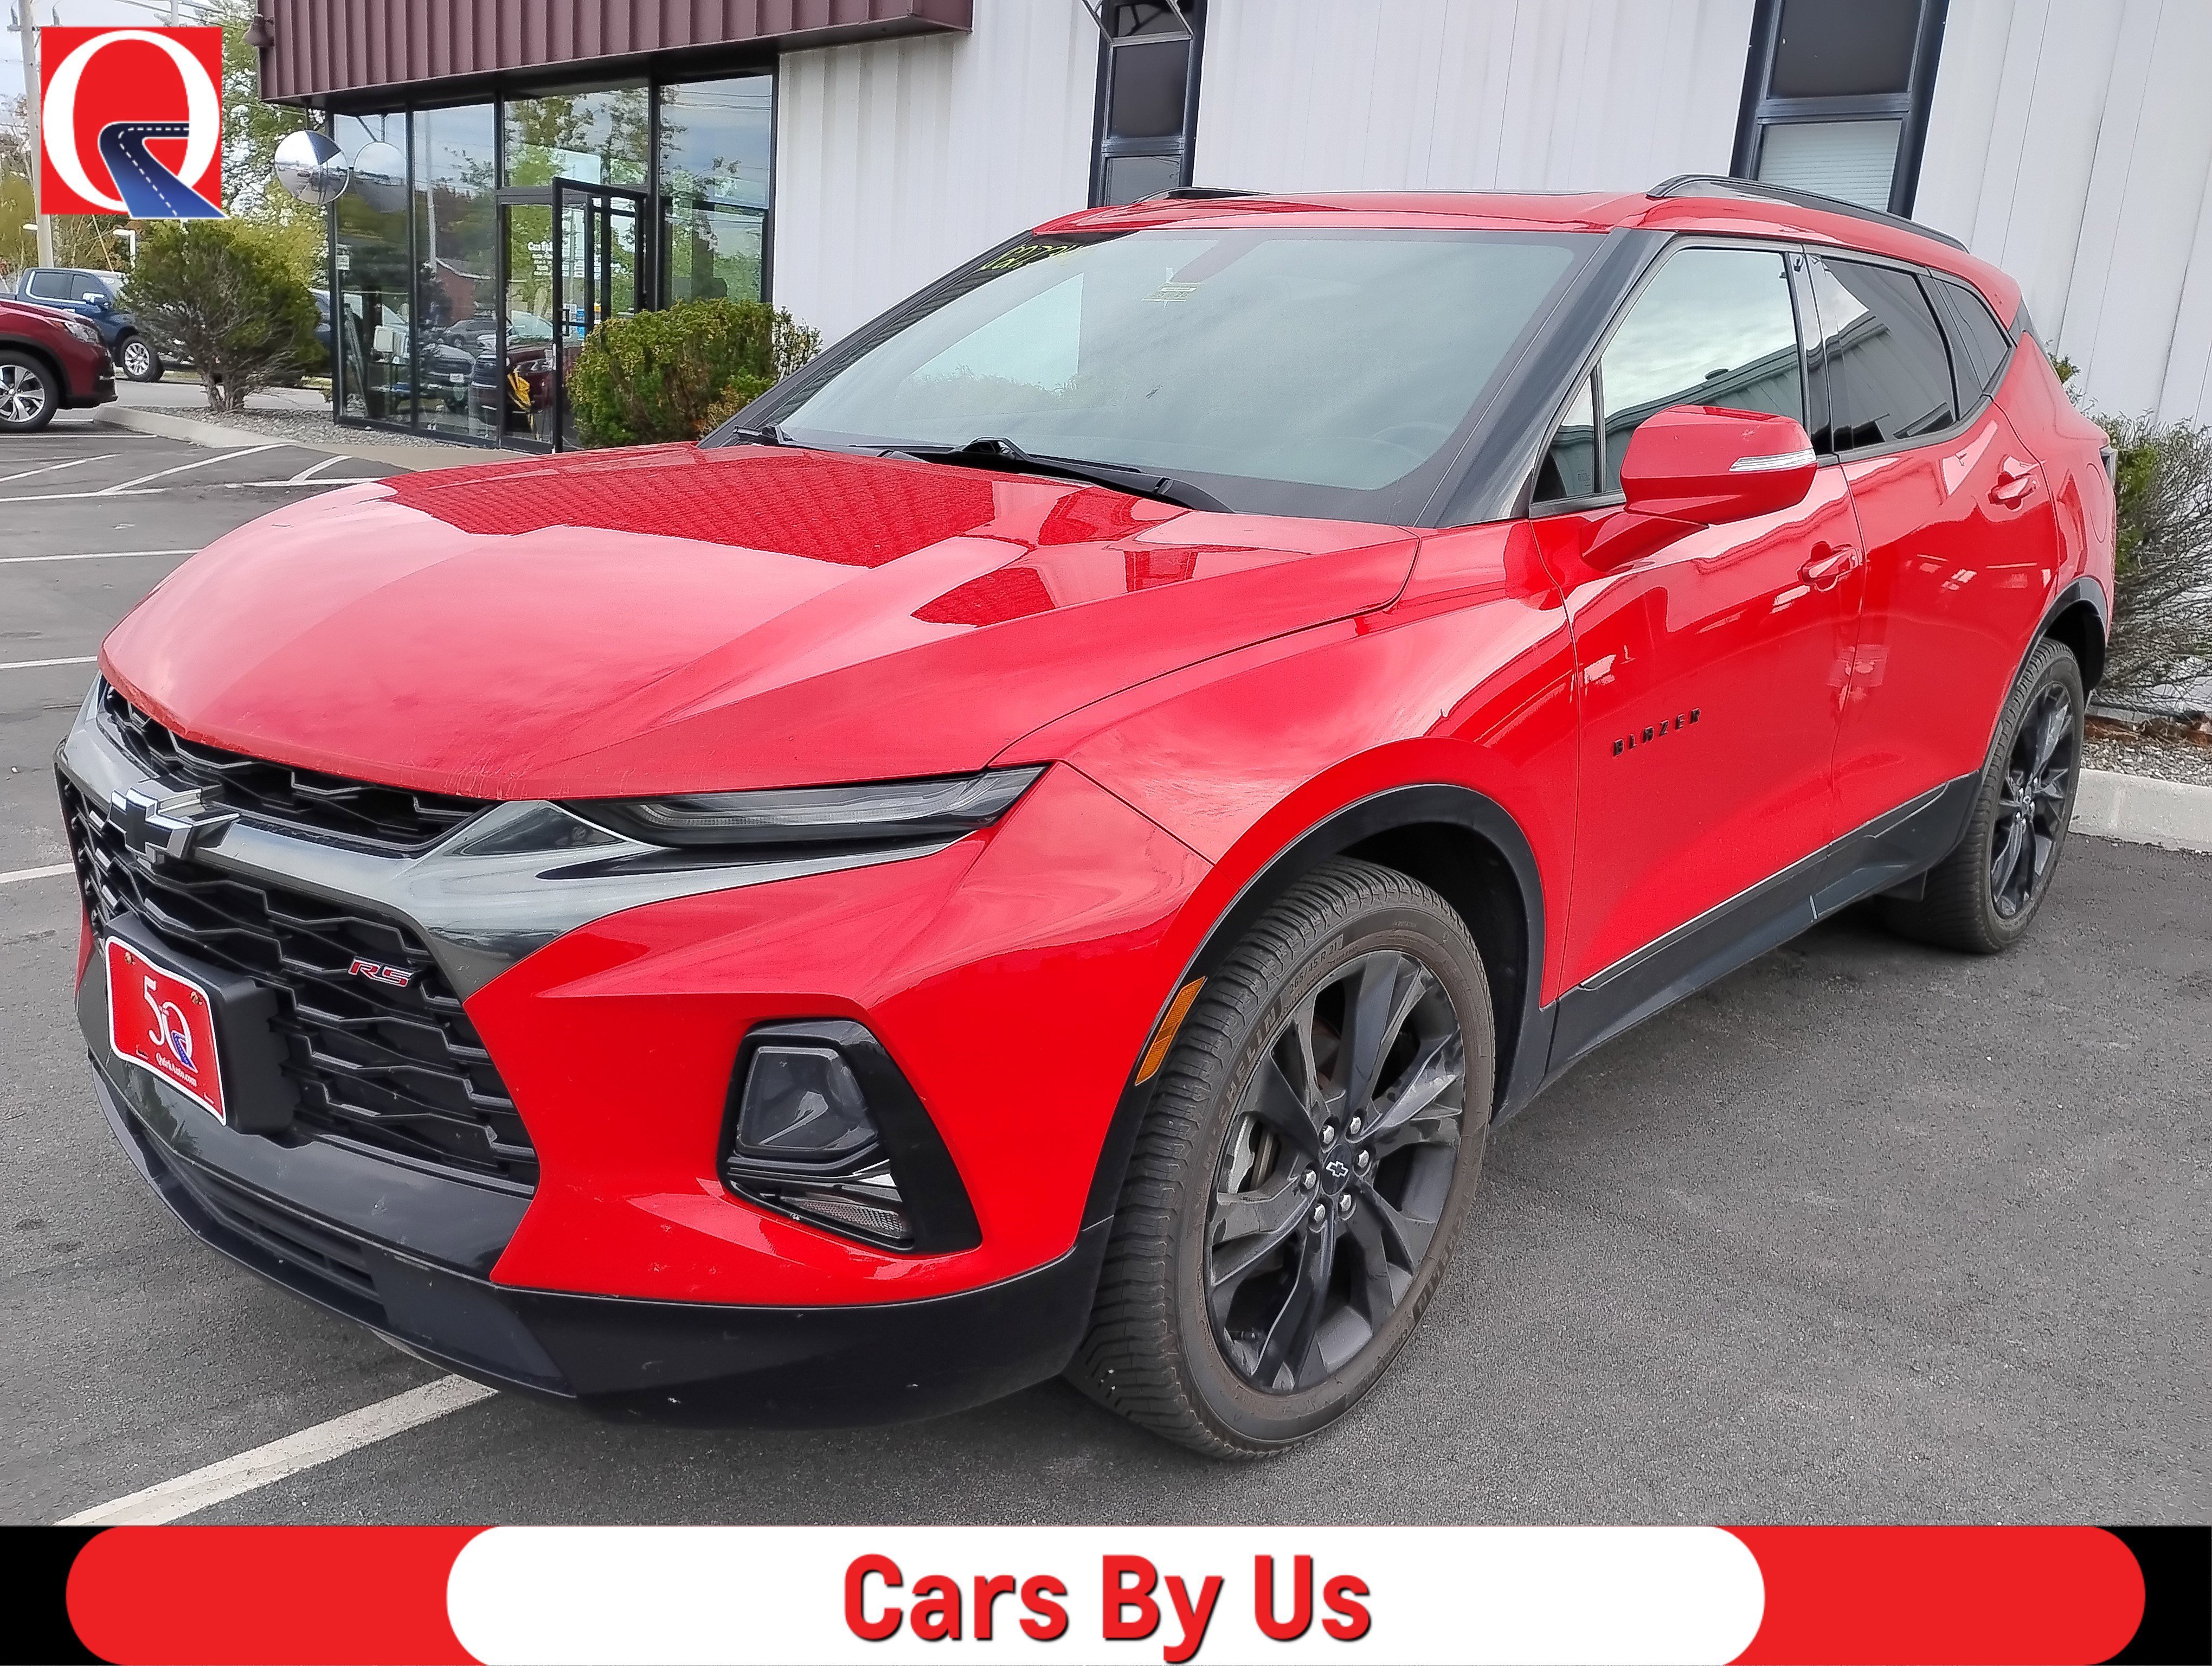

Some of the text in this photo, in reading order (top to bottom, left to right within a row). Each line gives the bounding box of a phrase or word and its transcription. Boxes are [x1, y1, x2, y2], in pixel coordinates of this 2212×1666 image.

[1613, 707, 1701, 757] BLAZER
[348, 959, 414, 988] RS
[1289, 959, 1319, 995] 265/45
[1320, 951, 1326, 962] R
[1329, 941, 1338, 955] 21
